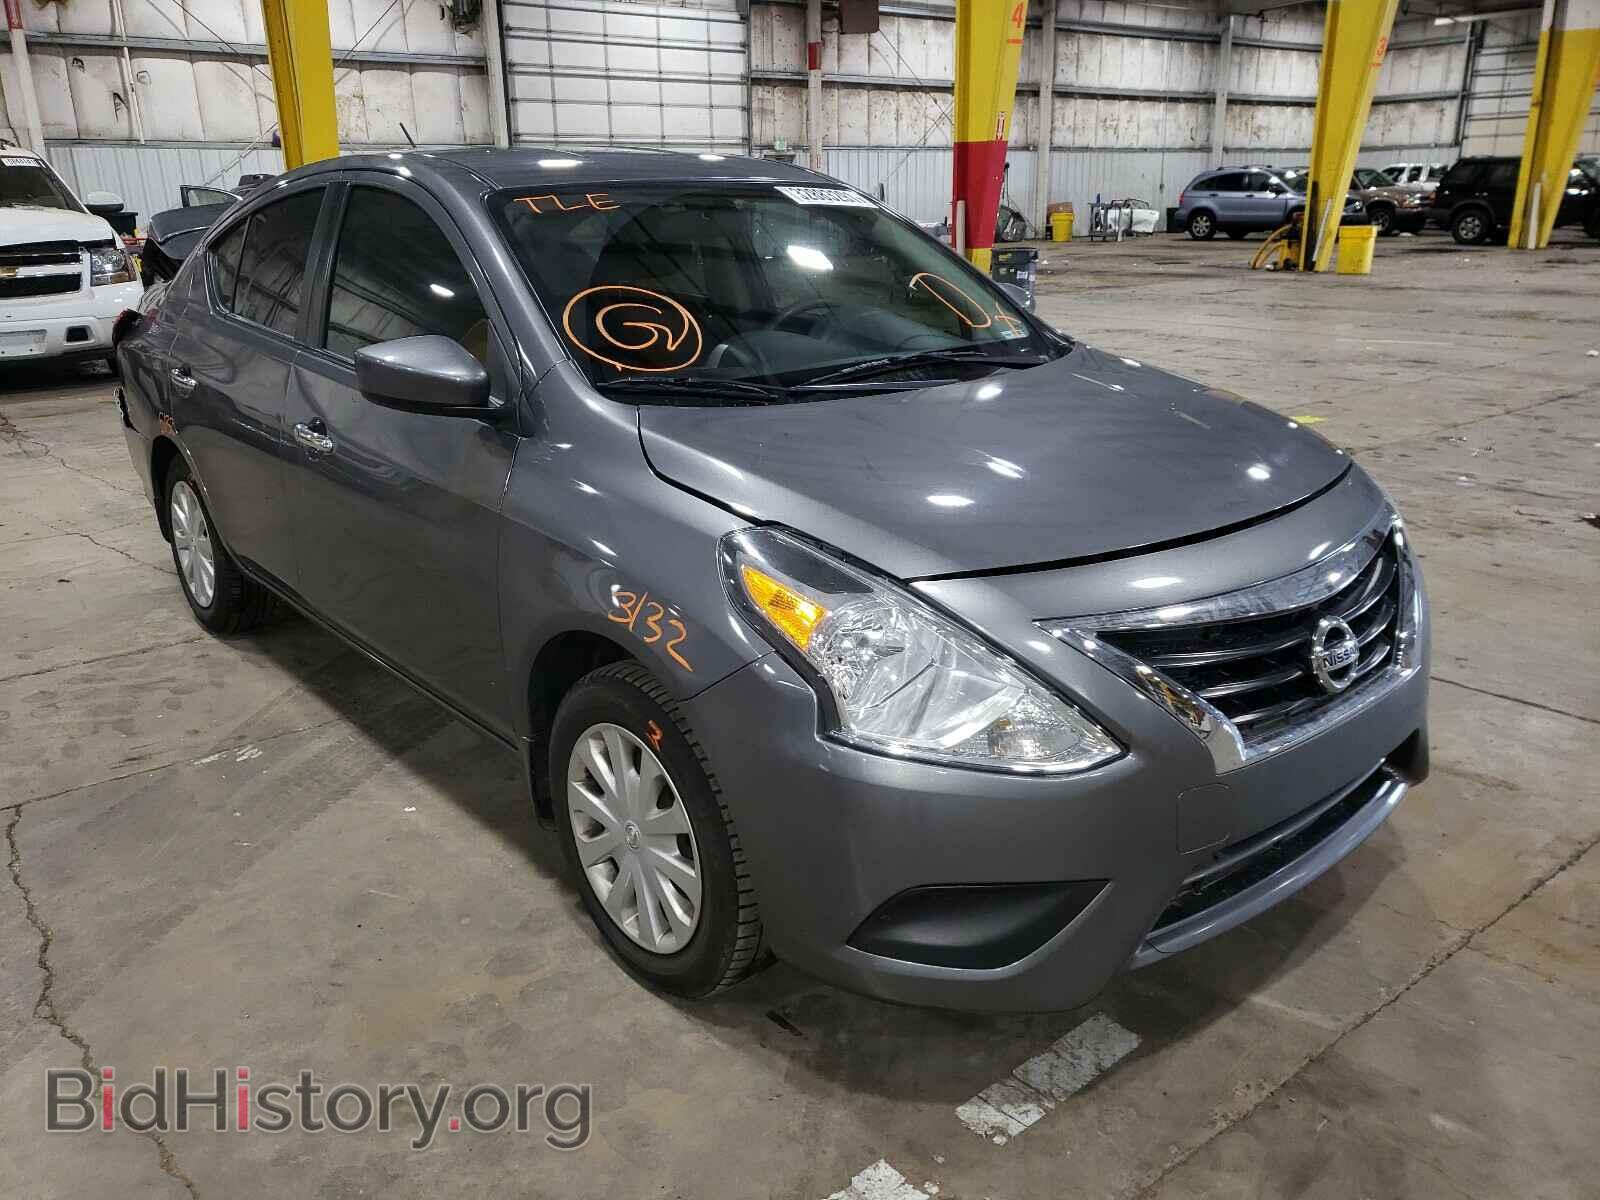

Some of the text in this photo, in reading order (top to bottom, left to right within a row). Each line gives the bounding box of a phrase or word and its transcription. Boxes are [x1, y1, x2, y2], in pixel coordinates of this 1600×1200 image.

[1012, 2, 1025, 29] 4
[513, 193, 621, 214] TLE
[607, 591, 694, 672] 3/32
